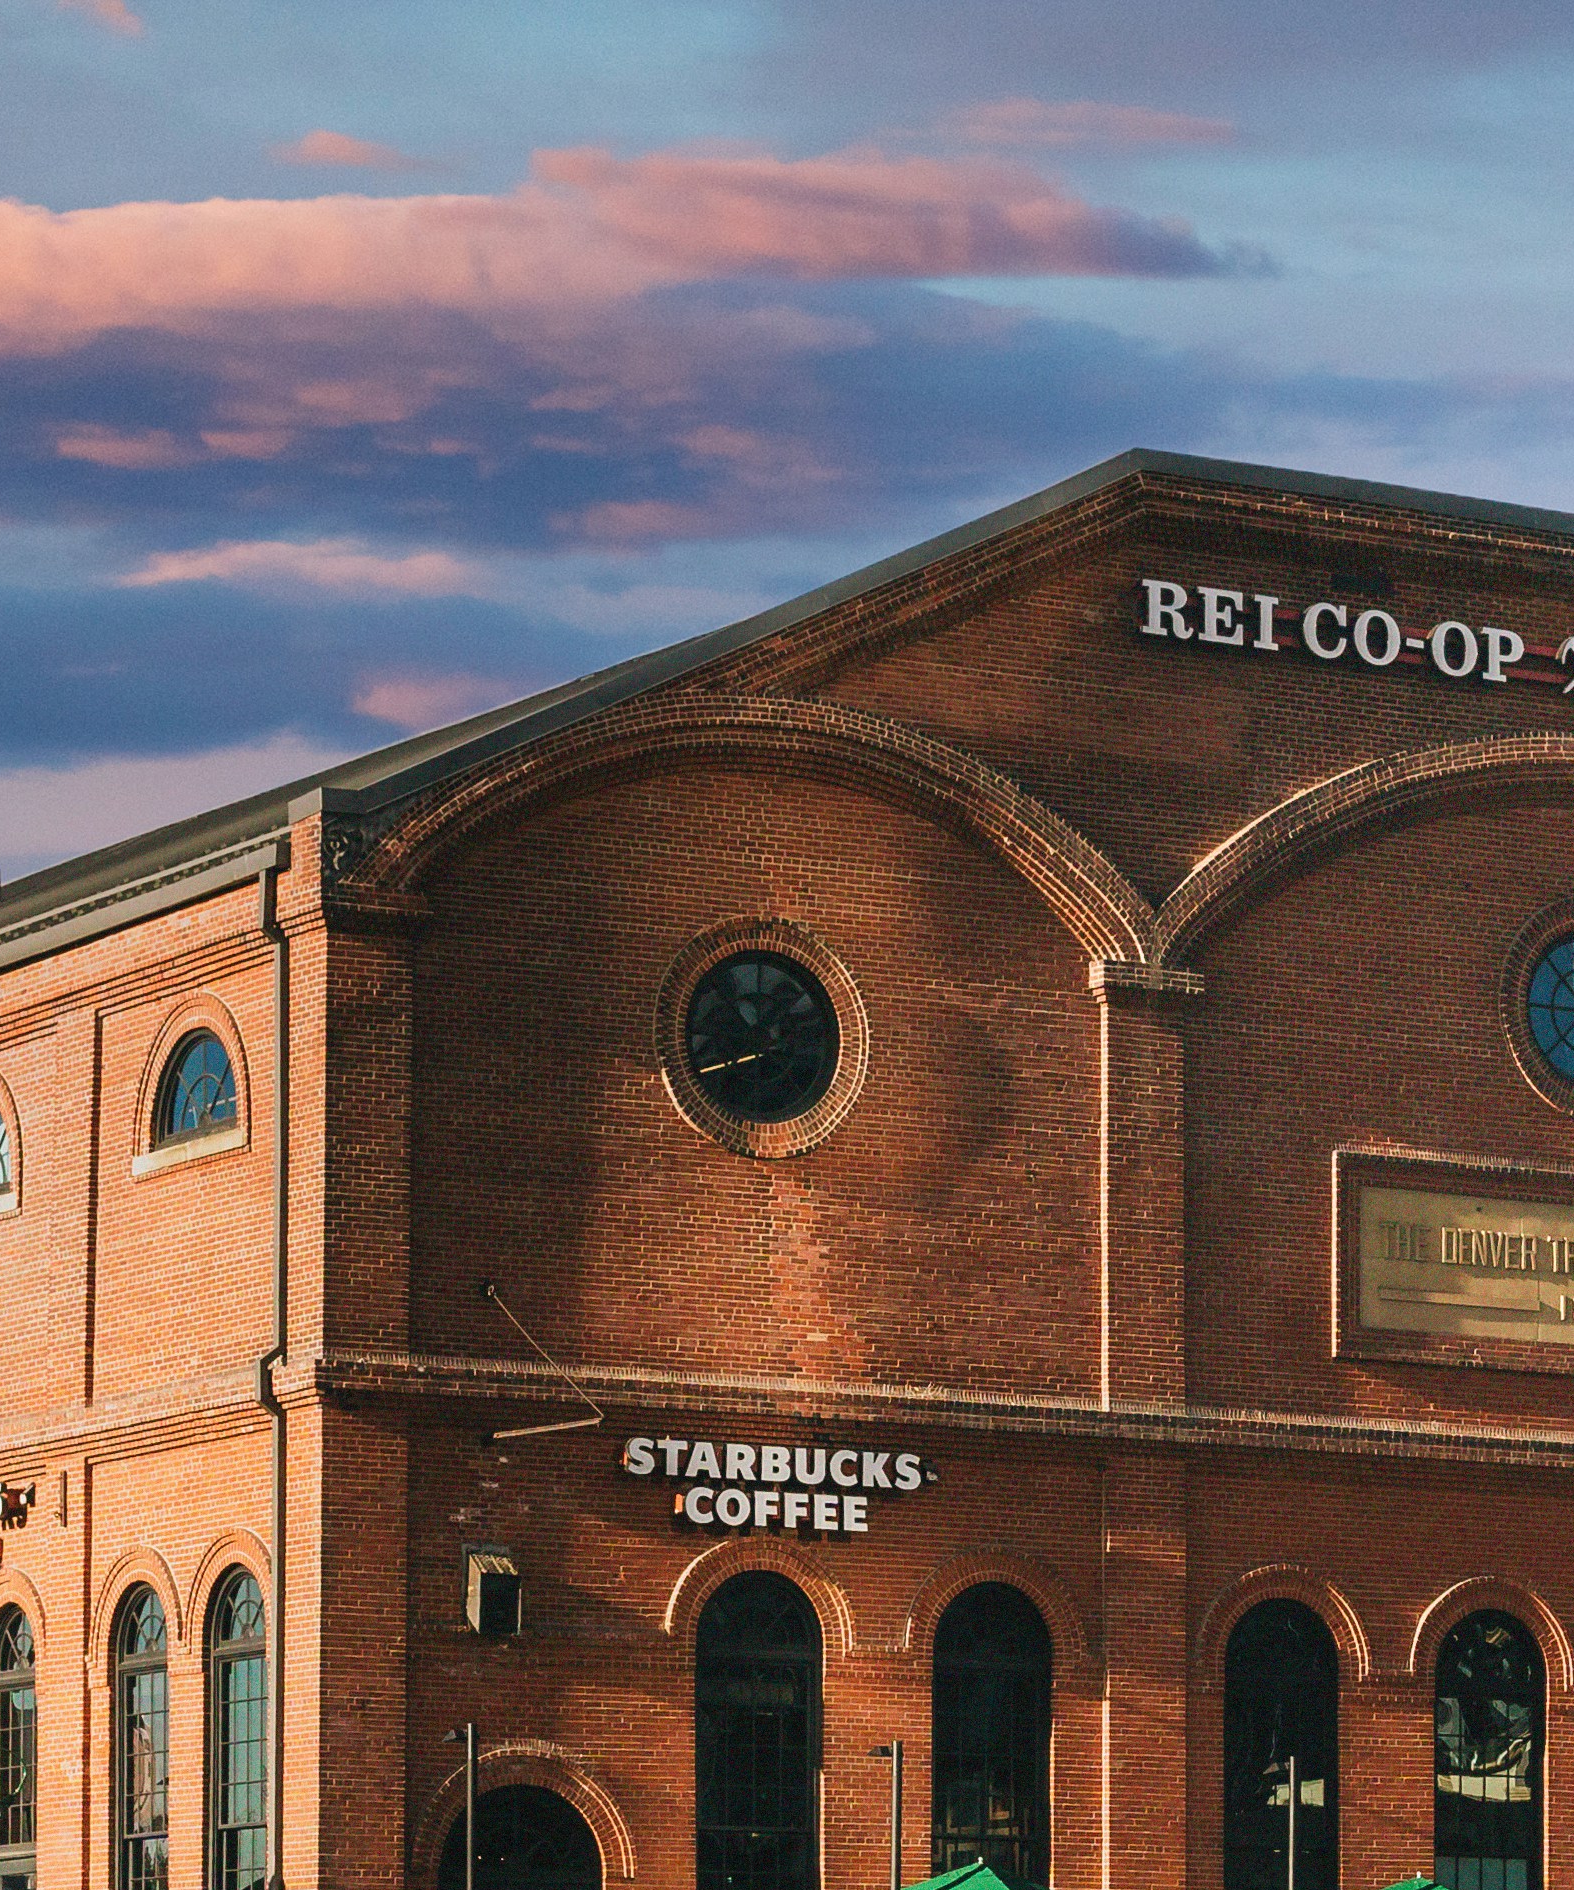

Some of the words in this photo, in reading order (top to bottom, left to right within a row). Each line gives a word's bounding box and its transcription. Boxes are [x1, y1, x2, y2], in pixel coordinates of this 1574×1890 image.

[1140, 579, 1279, 651] REI
[1303, 602, 1525, 683] CO-OP
[1379, 1221, 1430, 1260] THE
[1441, 1226, 1538, 1271] DENVER
[625, 1437, 922, 1490] STARBUCKS
[685, 1486, 869, 1532] COFFEE
